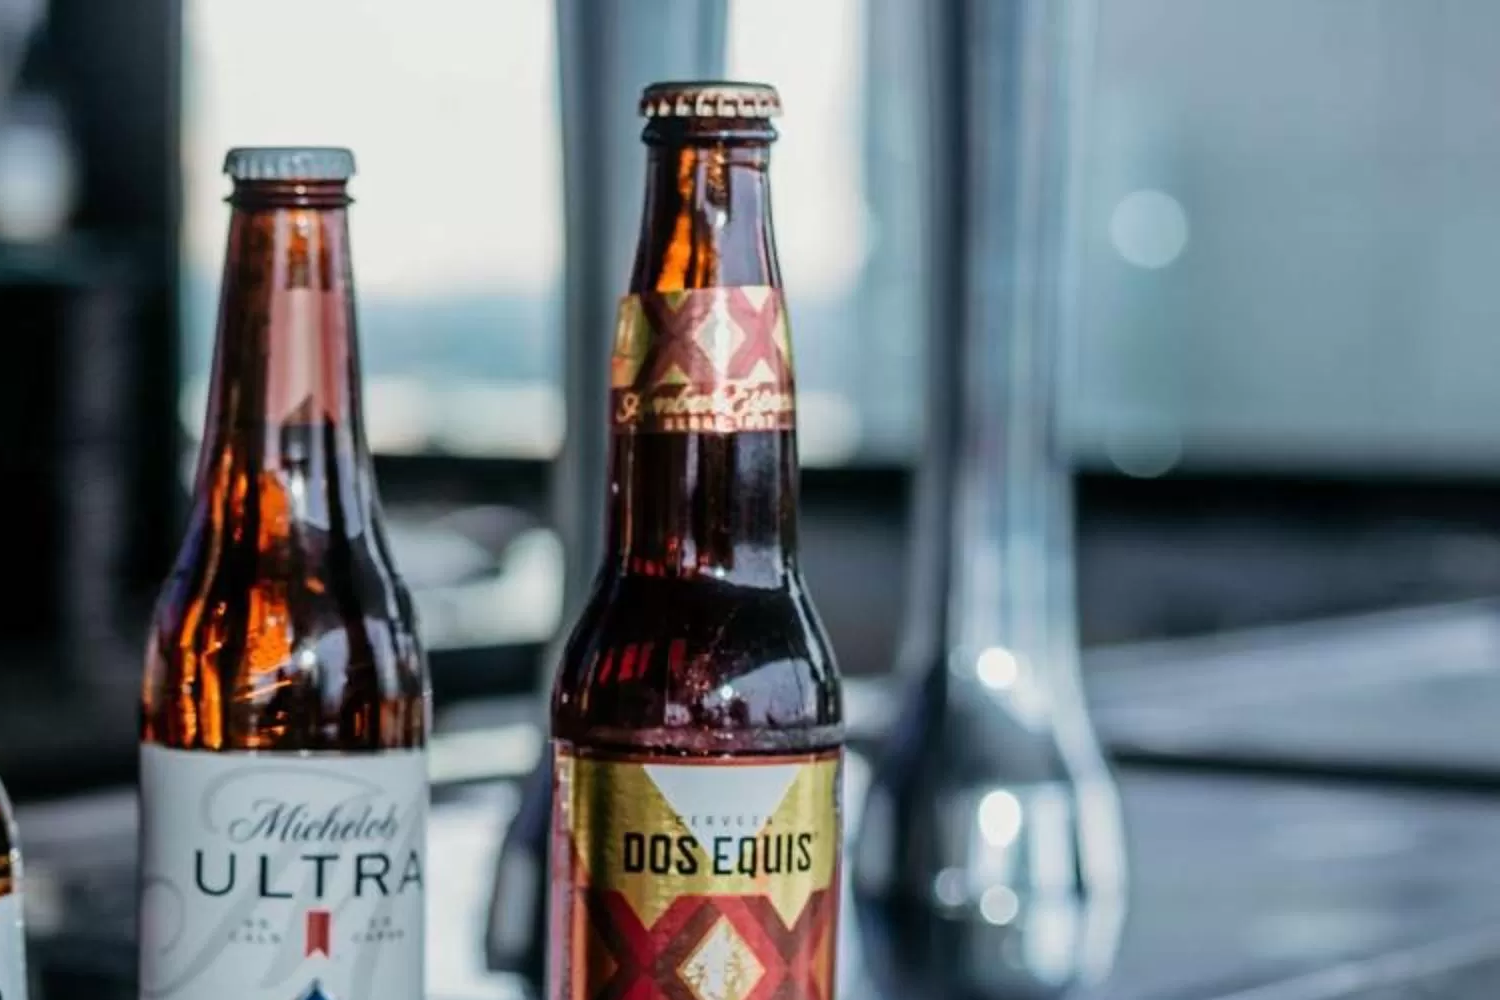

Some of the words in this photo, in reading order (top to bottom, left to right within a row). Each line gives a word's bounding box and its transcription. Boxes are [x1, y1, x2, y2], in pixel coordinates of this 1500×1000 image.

[195, 850, 424, 898] ULTRA
[624, 832, 699, 874] DOS
[713, 831, 812, 878] EQUIS
